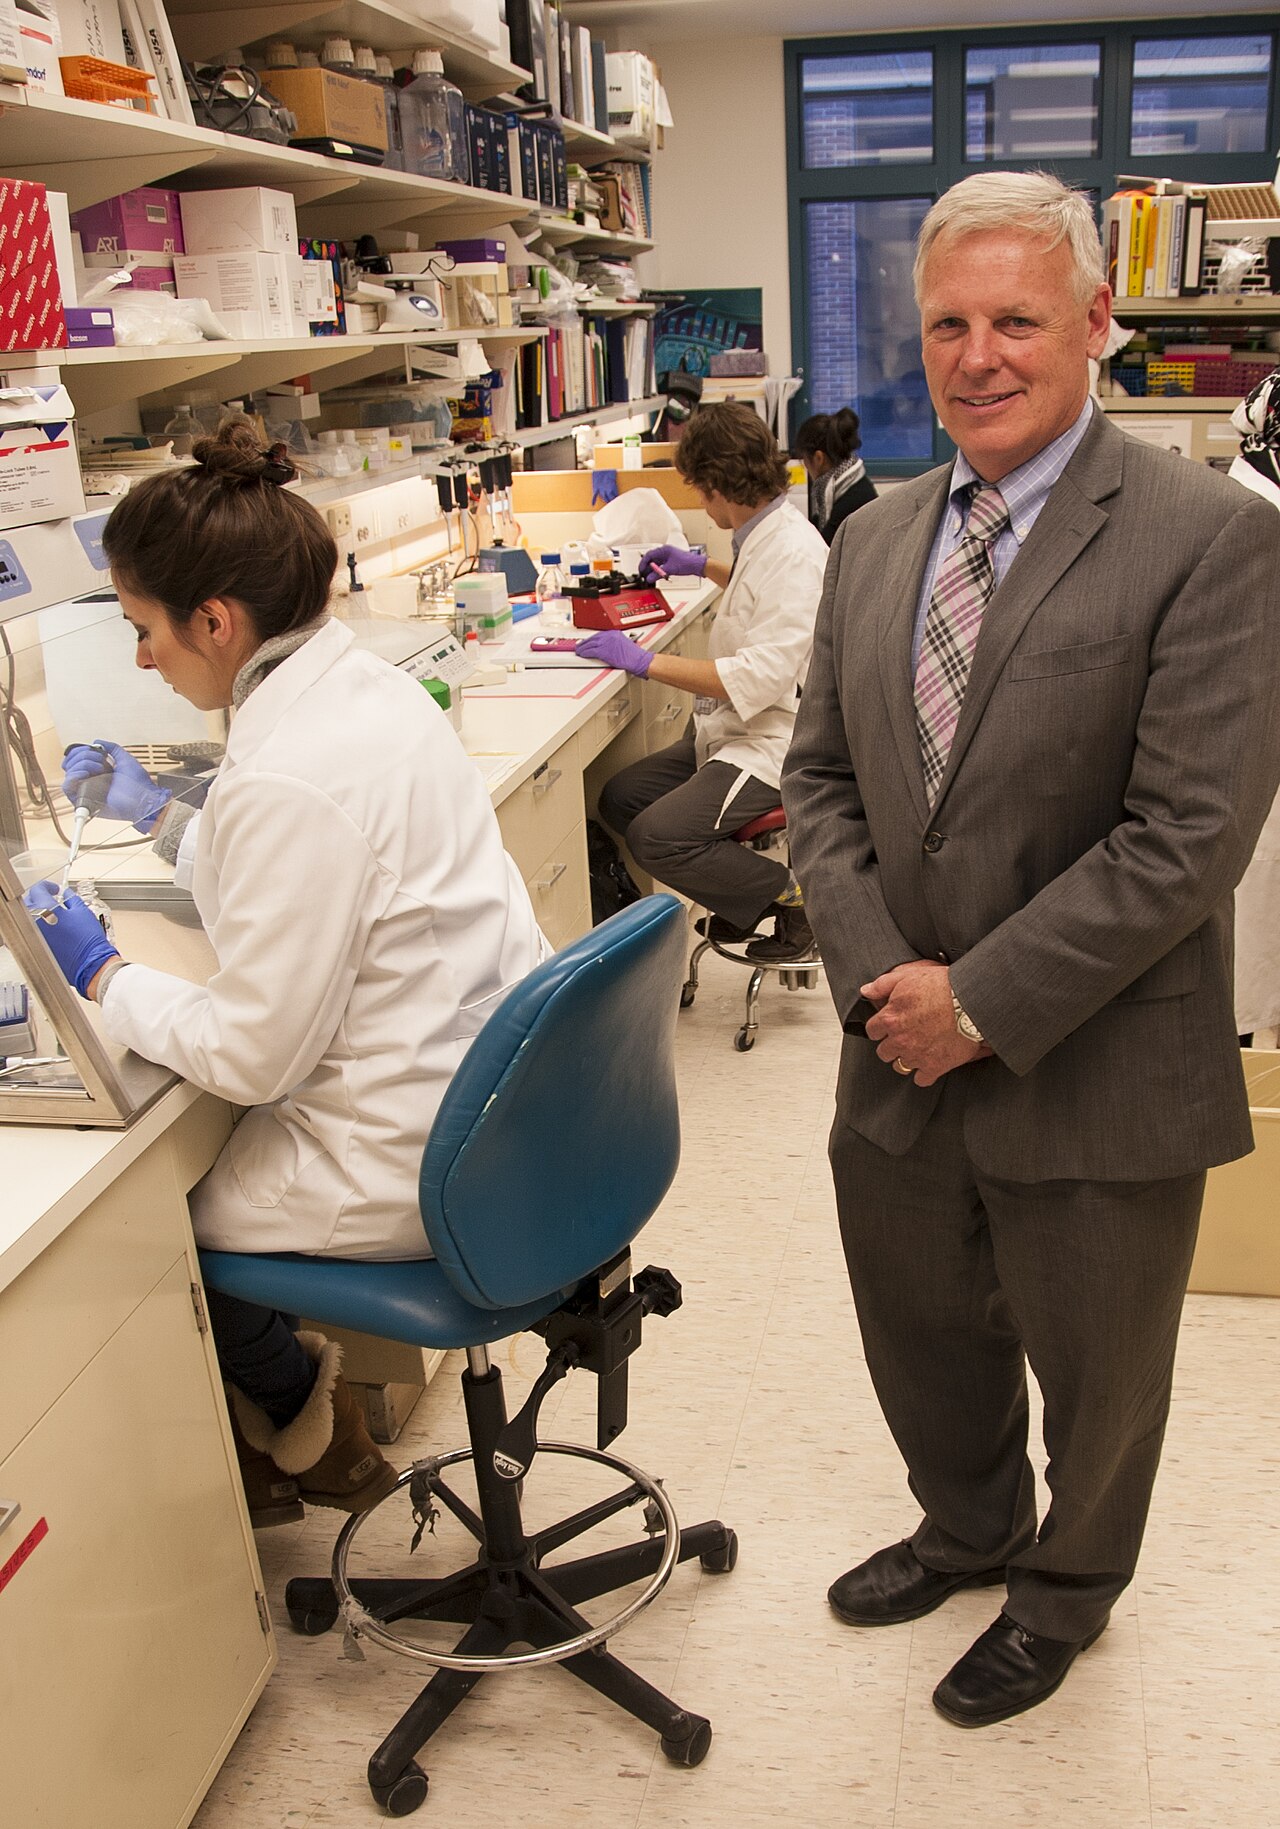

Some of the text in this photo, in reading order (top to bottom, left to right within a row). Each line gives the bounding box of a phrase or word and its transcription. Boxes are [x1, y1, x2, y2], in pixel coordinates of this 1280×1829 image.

[149, 28, 161, 56] USA
[13, 210, 24, 239] QIAGEN
[27, 235, 39, 264] QIAGEN
[96, 236, 119, 254] ART
[25, 274, 37, 304] QIAGEN
[42, 260, 53, 289] QIAGEN
[8, 289, 21, 319] QIAGEN
[39, 298, 51, 328] QIAGEN
[23, 313, 35, 343] QIAGEN
[356, 1460, 371, 1473] UGG
[278, 1484, 292, 1492] UGG
